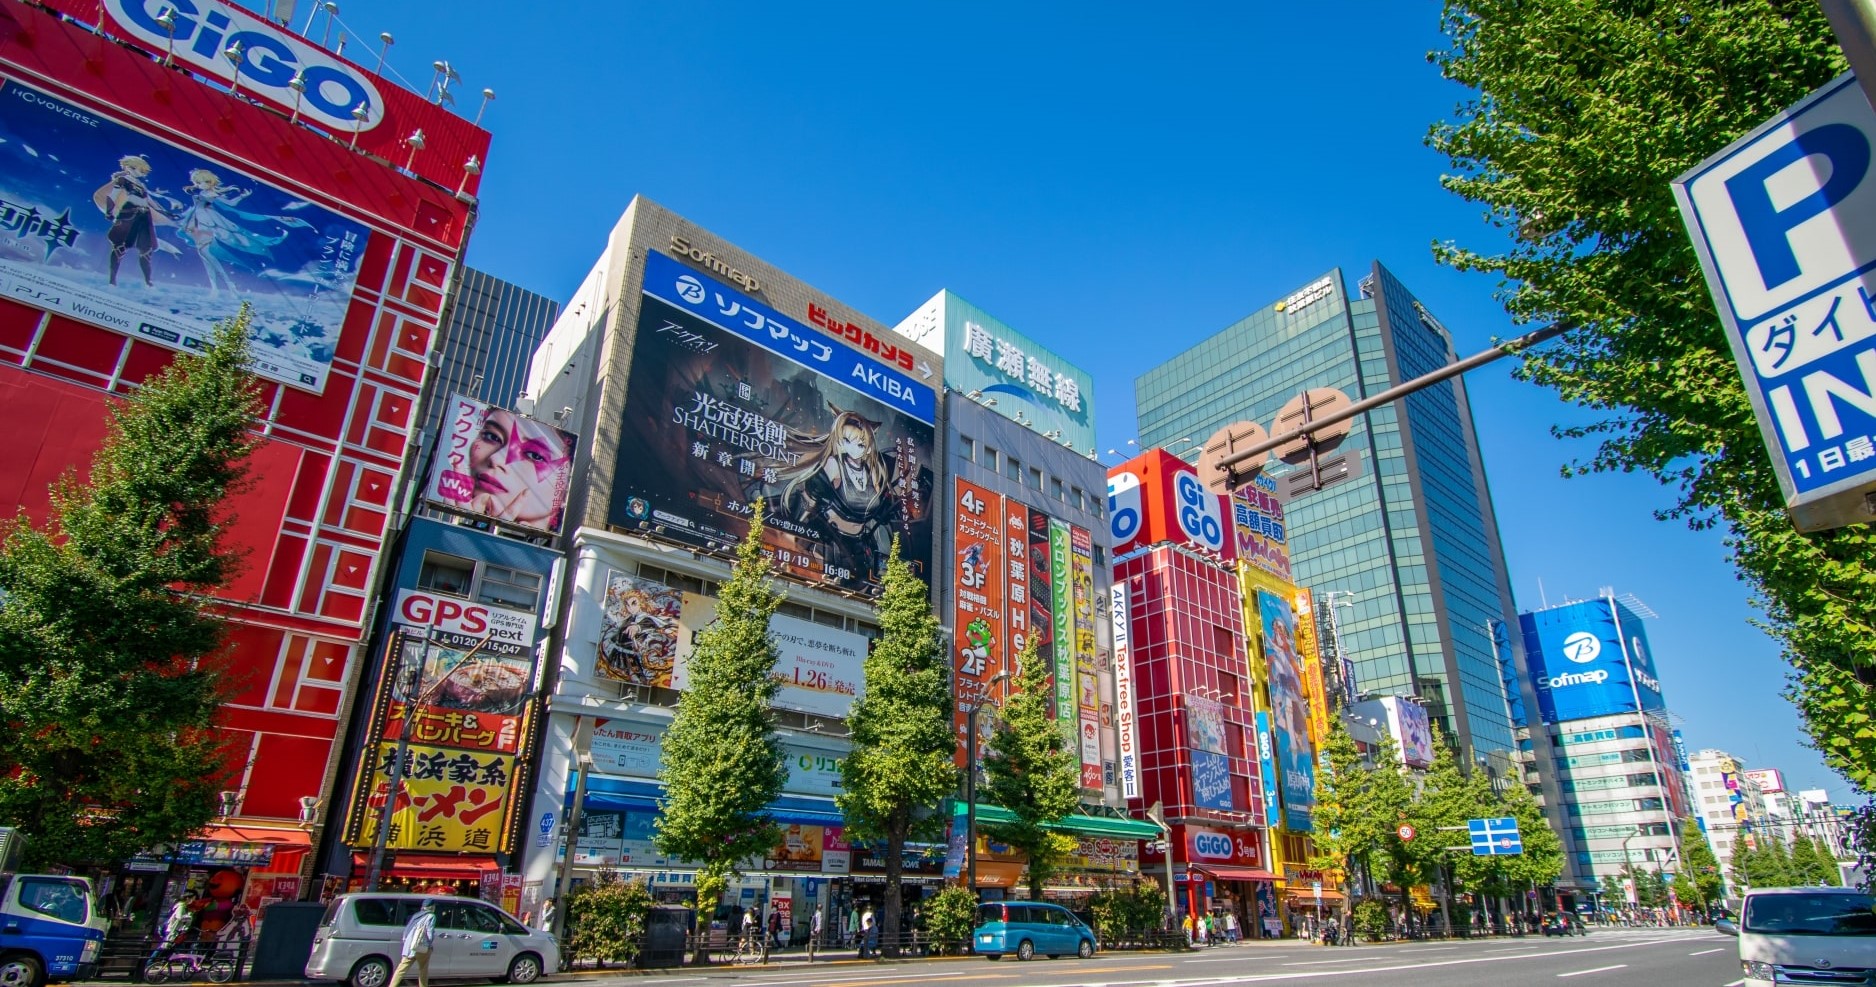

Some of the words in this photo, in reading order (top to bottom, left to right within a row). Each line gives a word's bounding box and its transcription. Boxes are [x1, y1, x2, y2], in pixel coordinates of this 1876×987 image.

[119, 0, 371, 121] GiGO
[1724, 123, 1871, 291] P
[670, 235, 760, 293] Sofmap
[15, 284, 61, 305] PS4
[72, 301, 130, 328] Windows
[715, 292, 832, 362] ソフマップ
[851, 362, 916, 406] AKIBA
[807, 302, 914, 371] ビックカメラ
[672, 406, 800, 468] SHATTERPOINT
[1796, 435, 1876, 478] 1日最
[960, 490, 985, 516] 4F
[959, 514, 999, 535] カードゲーム
[959, 524, 1000, 545] オンラインゲーム
[1236, 503, 1286, 545] 高額買取
[824, 563, 850, 580] 16:00
[960, 562, 985, 589] 3F
[401, 595, 489, 634] GPS
[491, 612, 527, 625] リアルタイム
[959, 601, 1000, 620] 麻雀・パズル
[1112, 589, 1126, 631] AKKY
[489, 626, 524, 642] next
[490, 619, 525, 631] GPS専門店
[960, 648, 986, 676] 2F
[1116, 643, 1130, 709] Tax-free
[834, 680, 856, 696] 発売
[1537, 669, 1609, 690] Sofmap
[413, 722, 496, 747] ハンバーグ
[497, 719, 518, 748] 2F
[1120, 712, 1132, 753] Shop
[368, 779, 504, 826] ラーメン
[1196, 833, 1232, 856] GiGO
